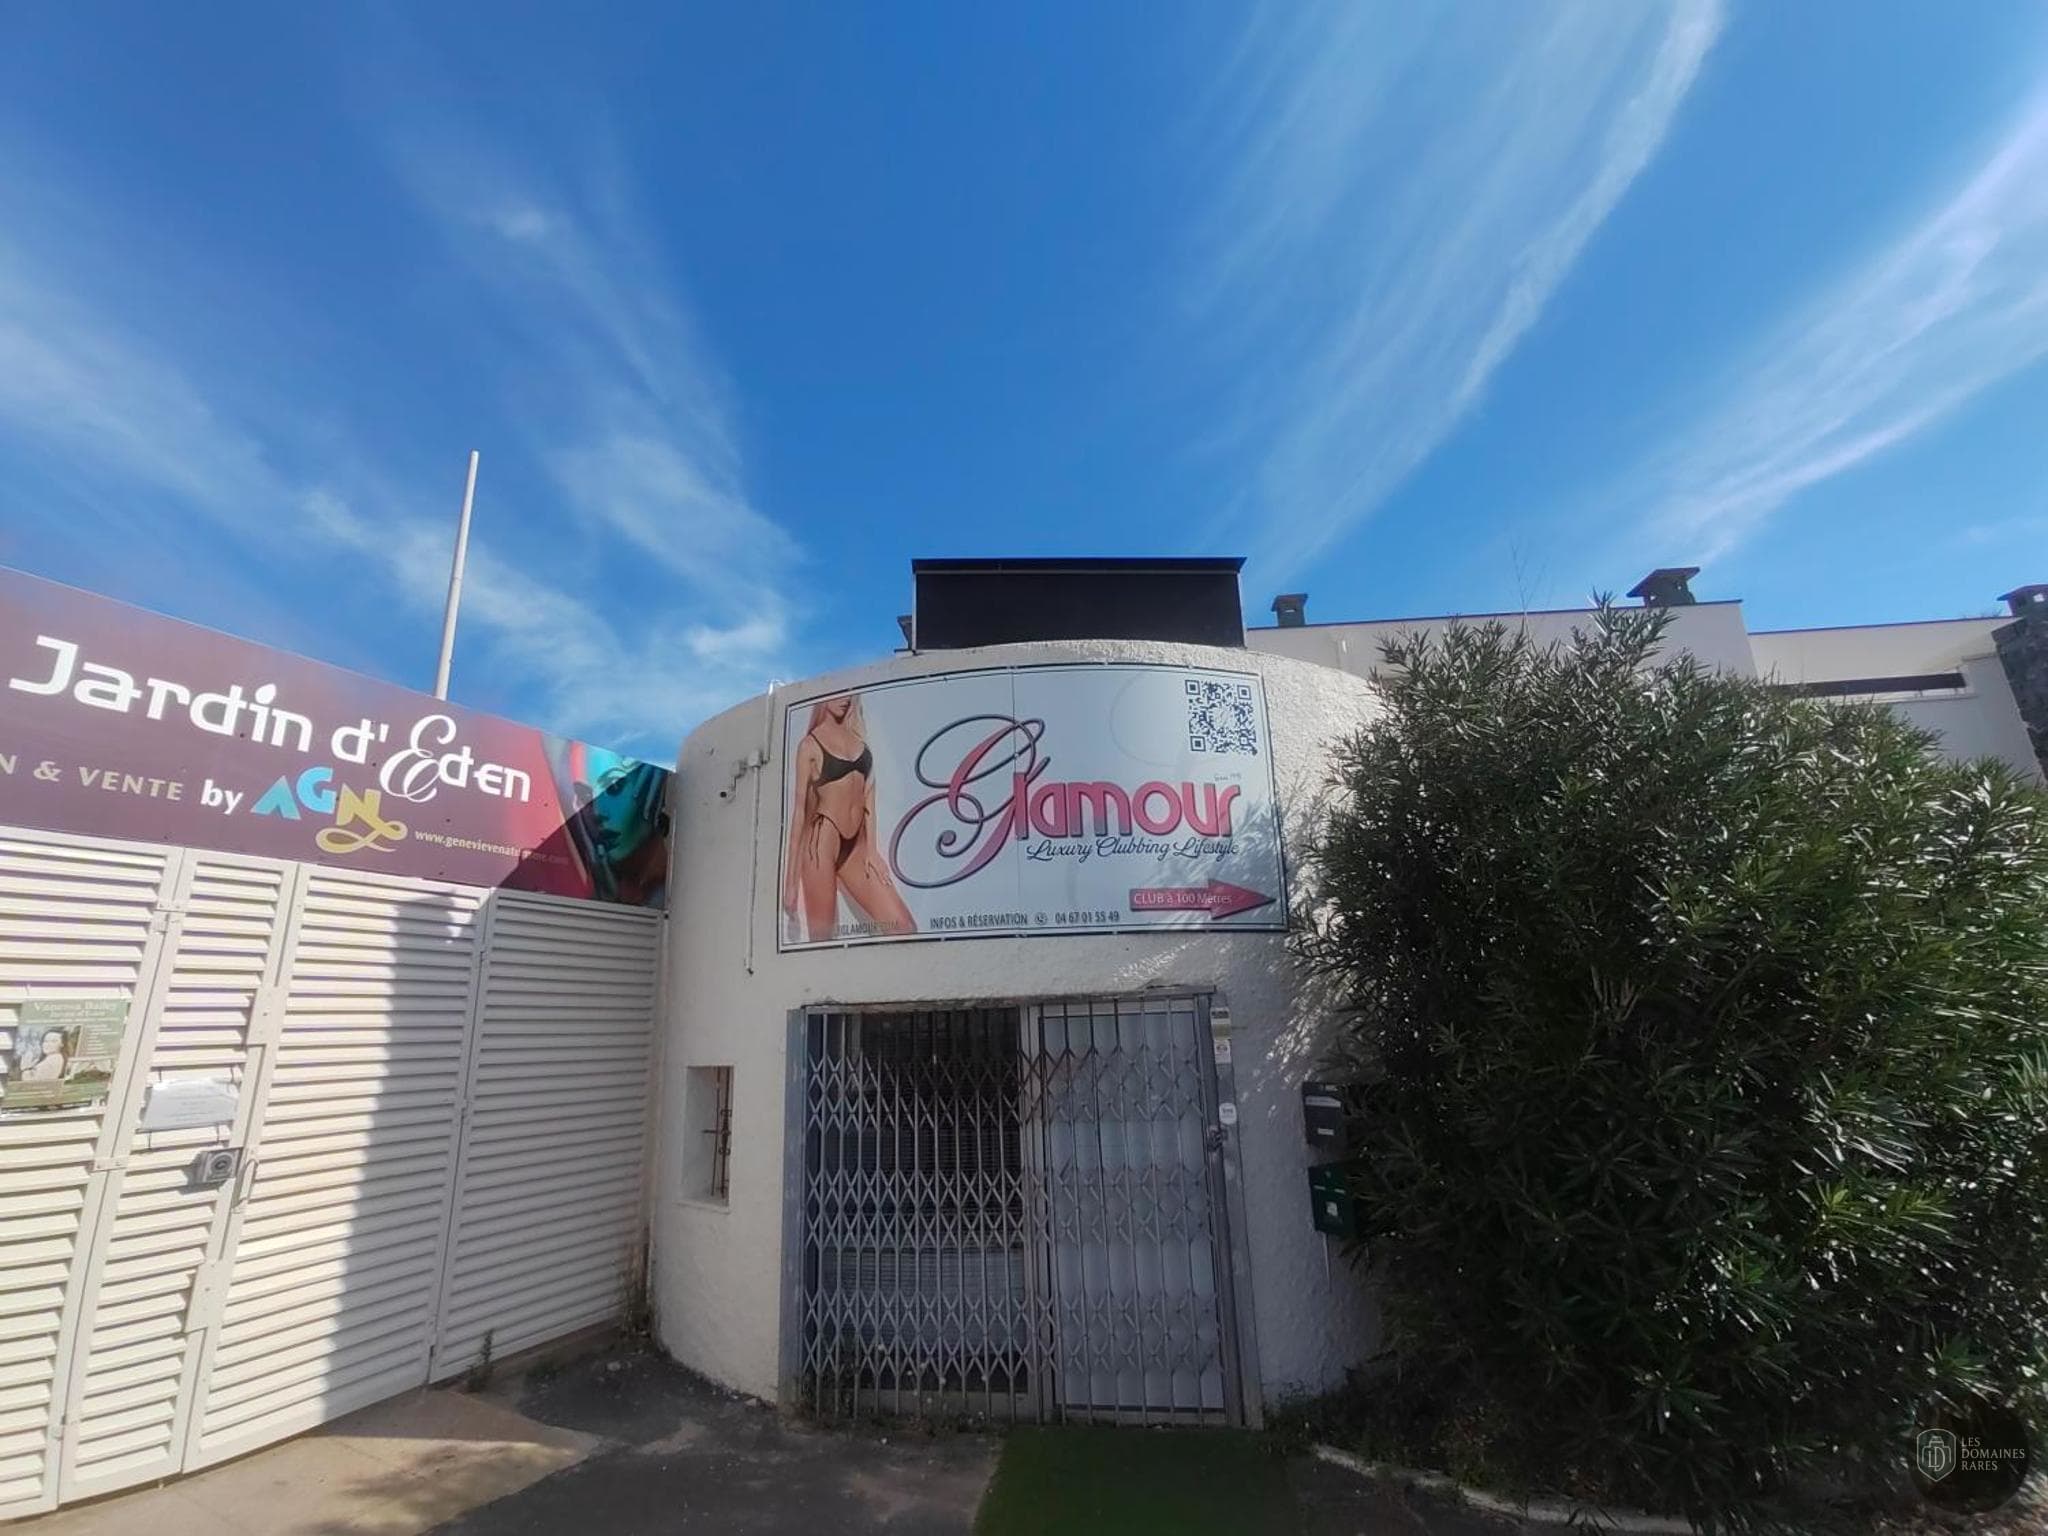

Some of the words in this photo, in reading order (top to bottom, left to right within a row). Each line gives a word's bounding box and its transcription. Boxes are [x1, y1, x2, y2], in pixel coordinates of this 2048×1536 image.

[9, 635, 313, 753] Jardin
[33, 760, 61, 782] &
[78, 766, 184, 801] VENTE
[200, 779, 244, 815] by
[888, 713, 1241, 889] Glamour
[1026, 839, 1092, 863] Luxury
[1096, 836, 1169, 861] Clubbing
[1173, 837, 1239, 862] Lifestyle
[1134, 892, 1164, 905] CLUB
[1177, 892, 1196, 904] 100
[930, 916, 957, 929] INFOS
[1055, 911, 1067, 924] 04
[1068, 911, 1080, 923] 67
[1081, 911, 1092, 923] 01
[1094, 910, 1106, 922] 55
[1108, 910, 1119, 922] 49
